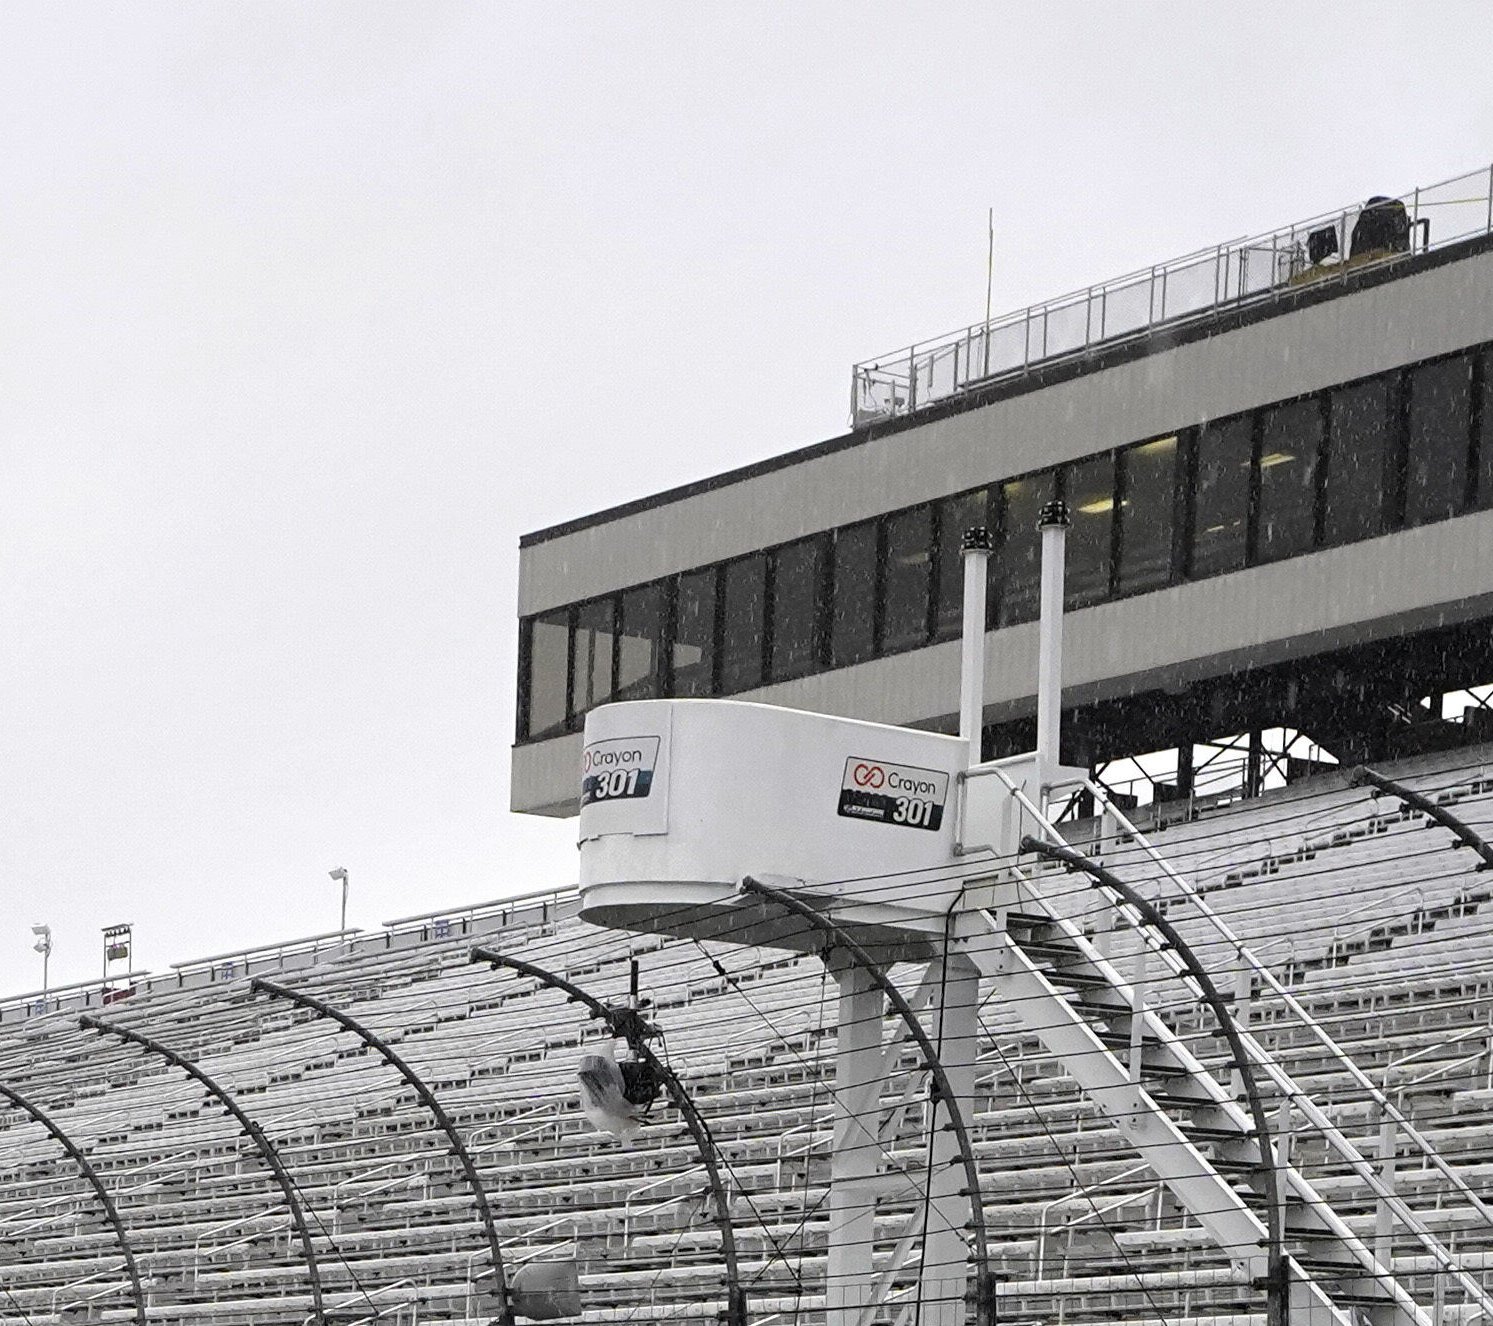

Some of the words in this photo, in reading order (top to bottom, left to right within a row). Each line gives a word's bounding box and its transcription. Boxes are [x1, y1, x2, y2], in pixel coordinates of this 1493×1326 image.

[592, 750, 642, 766] Crayon
[595, 767, 640, 798] 301
[888, 772, 936, 795] Crayon
[892, 796, 934, 826] 301
